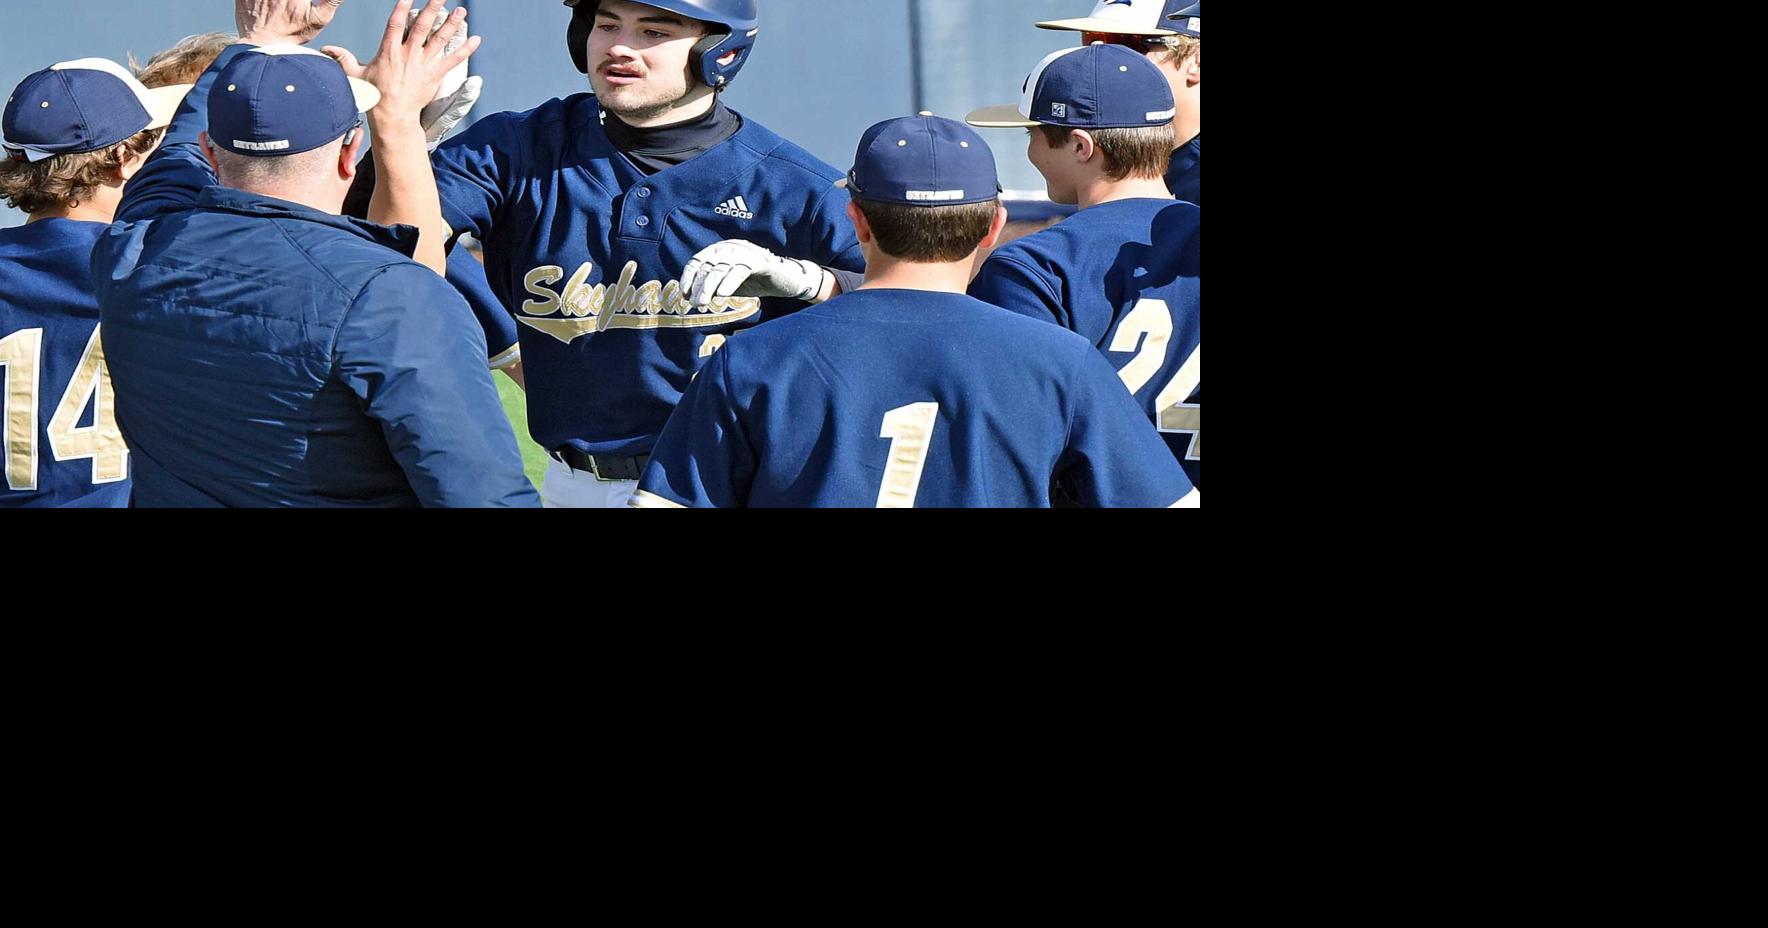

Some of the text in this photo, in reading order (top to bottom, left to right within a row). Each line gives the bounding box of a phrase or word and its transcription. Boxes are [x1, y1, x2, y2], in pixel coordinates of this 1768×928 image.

[714, 206, 753, 219] adidas
[0, 322, 130, 490] 14
[876, 402, 939, 508] 1
